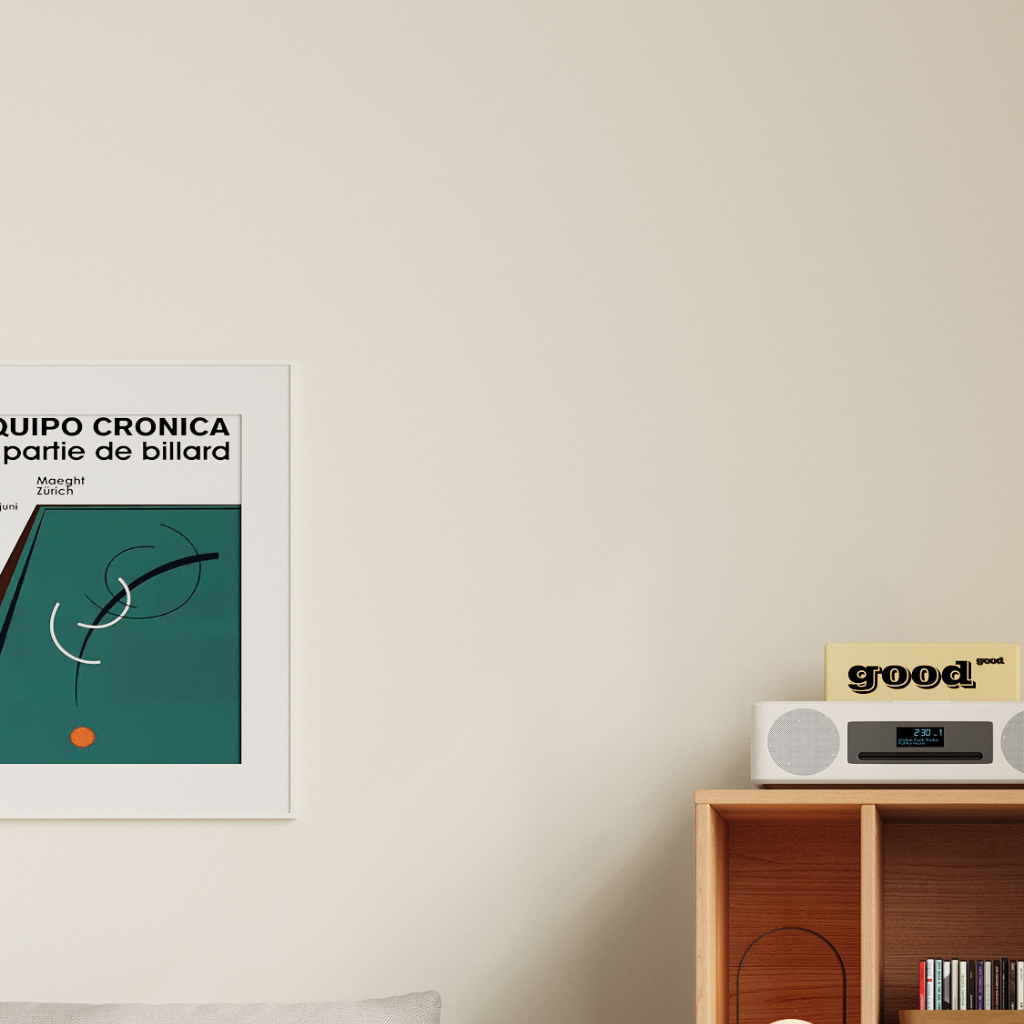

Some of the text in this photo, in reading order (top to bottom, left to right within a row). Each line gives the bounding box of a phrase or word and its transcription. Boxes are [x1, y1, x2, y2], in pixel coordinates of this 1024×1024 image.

[93, 417, 230, 436] CRONICA
[4, 442, 230, 465] partie de billard
[36, 476, 86, 487] Maeght
[36, 486, 74, 496] Zürich
[976, 656, 1005, 666] good
[848, 660, 976, 694] good
